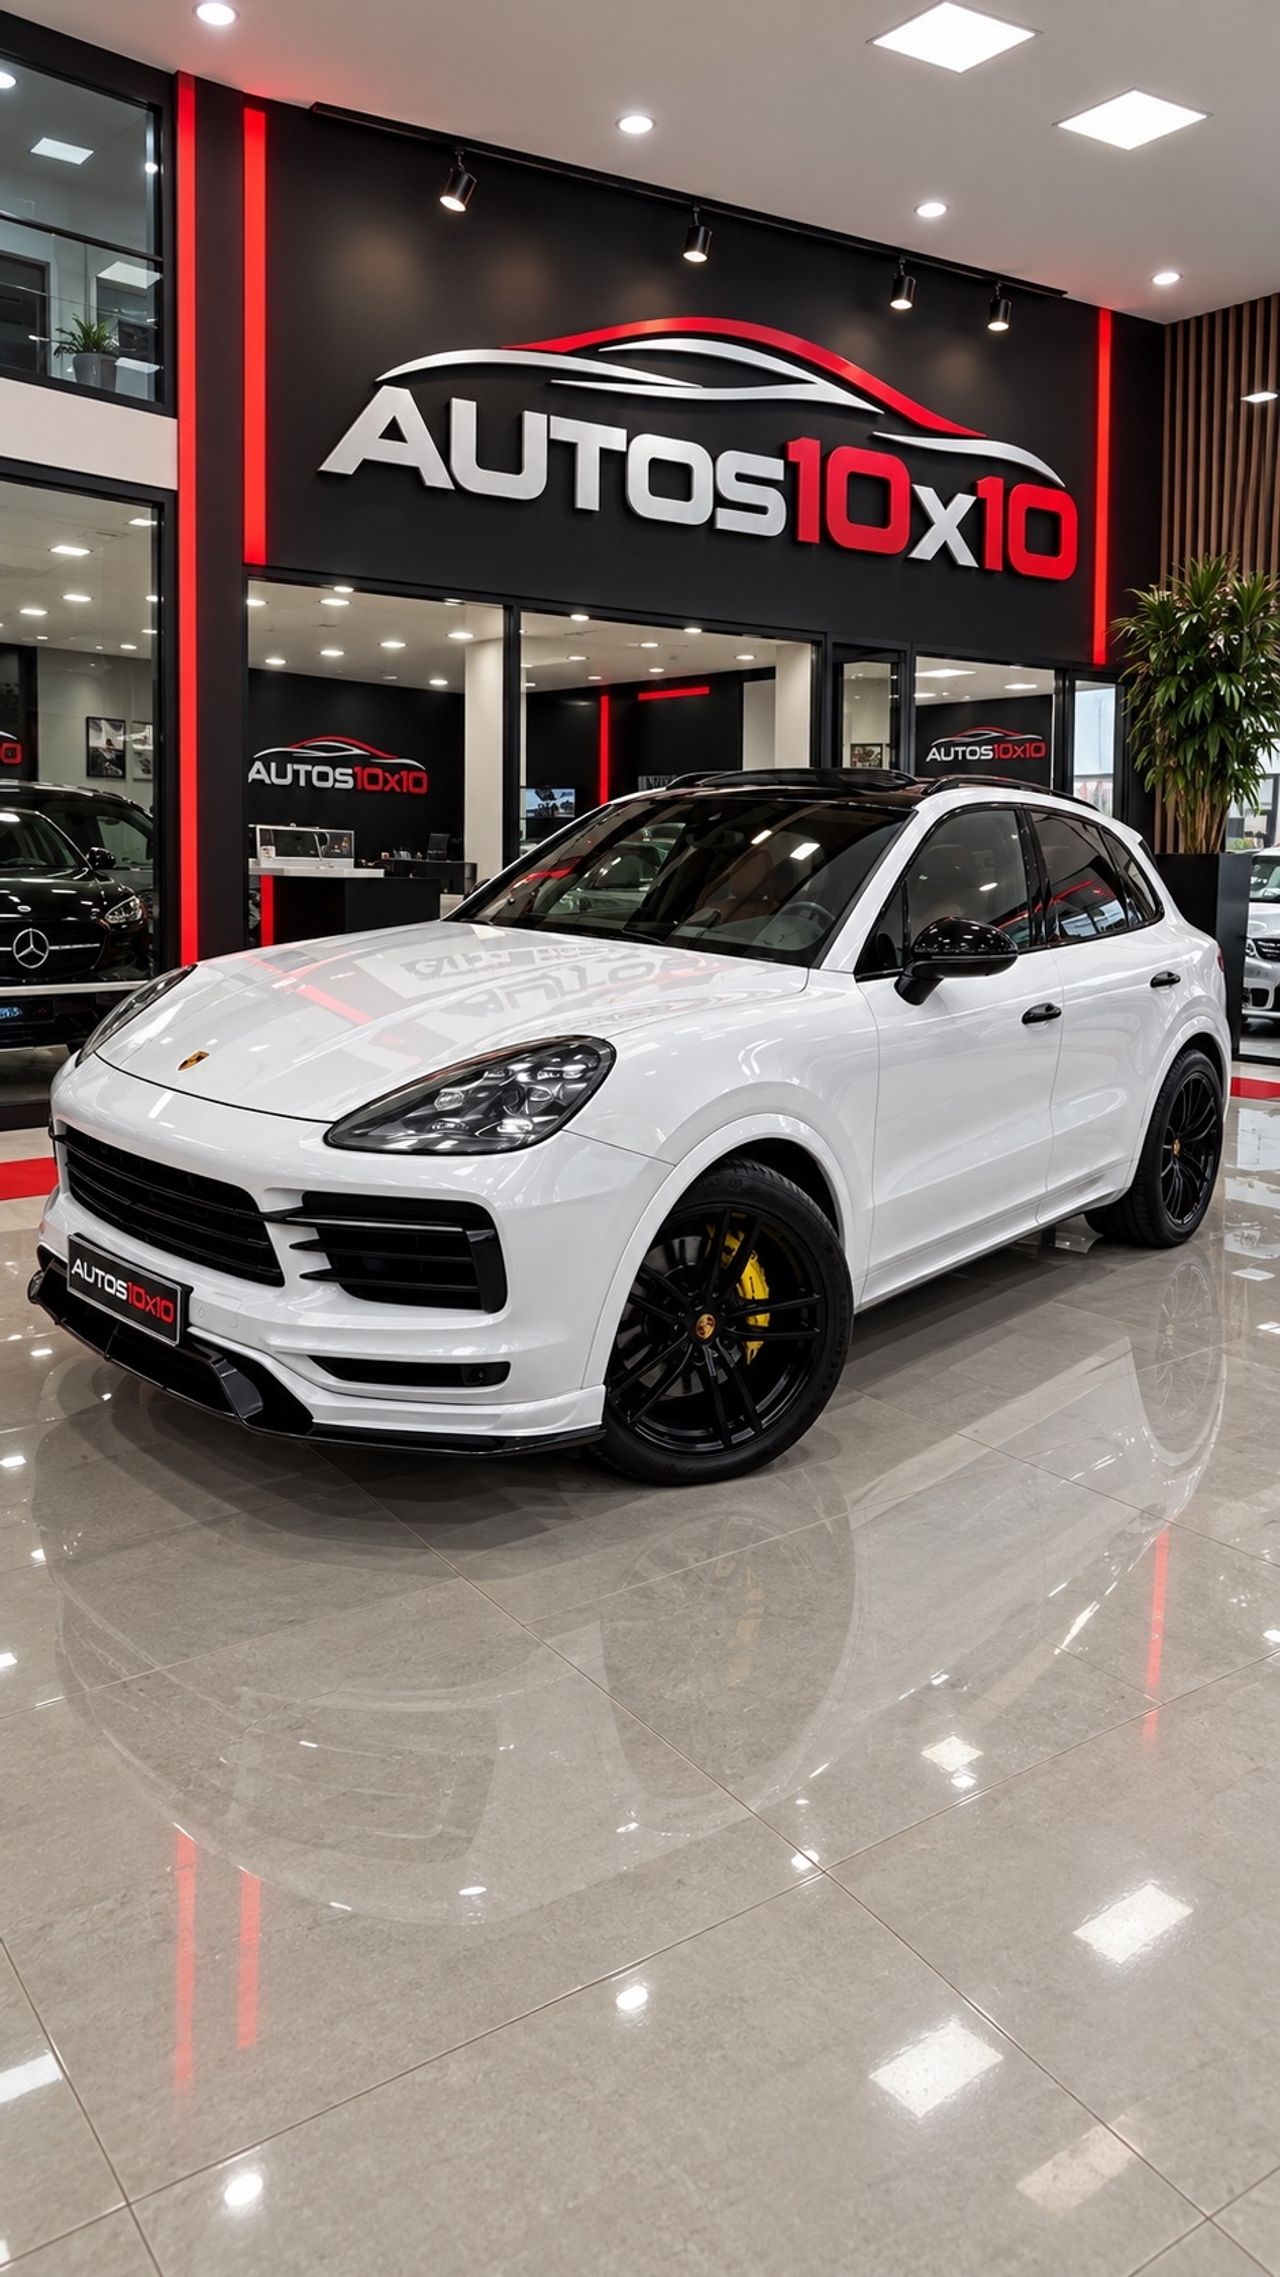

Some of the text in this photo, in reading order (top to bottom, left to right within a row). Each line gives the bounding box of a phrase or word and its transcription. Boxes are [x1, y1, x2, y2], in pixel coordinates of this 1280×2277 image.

[318, 384, 1080, 581] AUTOS10x10
[247, 760, 429, 794] AUTOS10x10
[925, 742, 1046, 762] AUTOS10x10
[71, 1258, 174, 1324] AUTOS10x10
